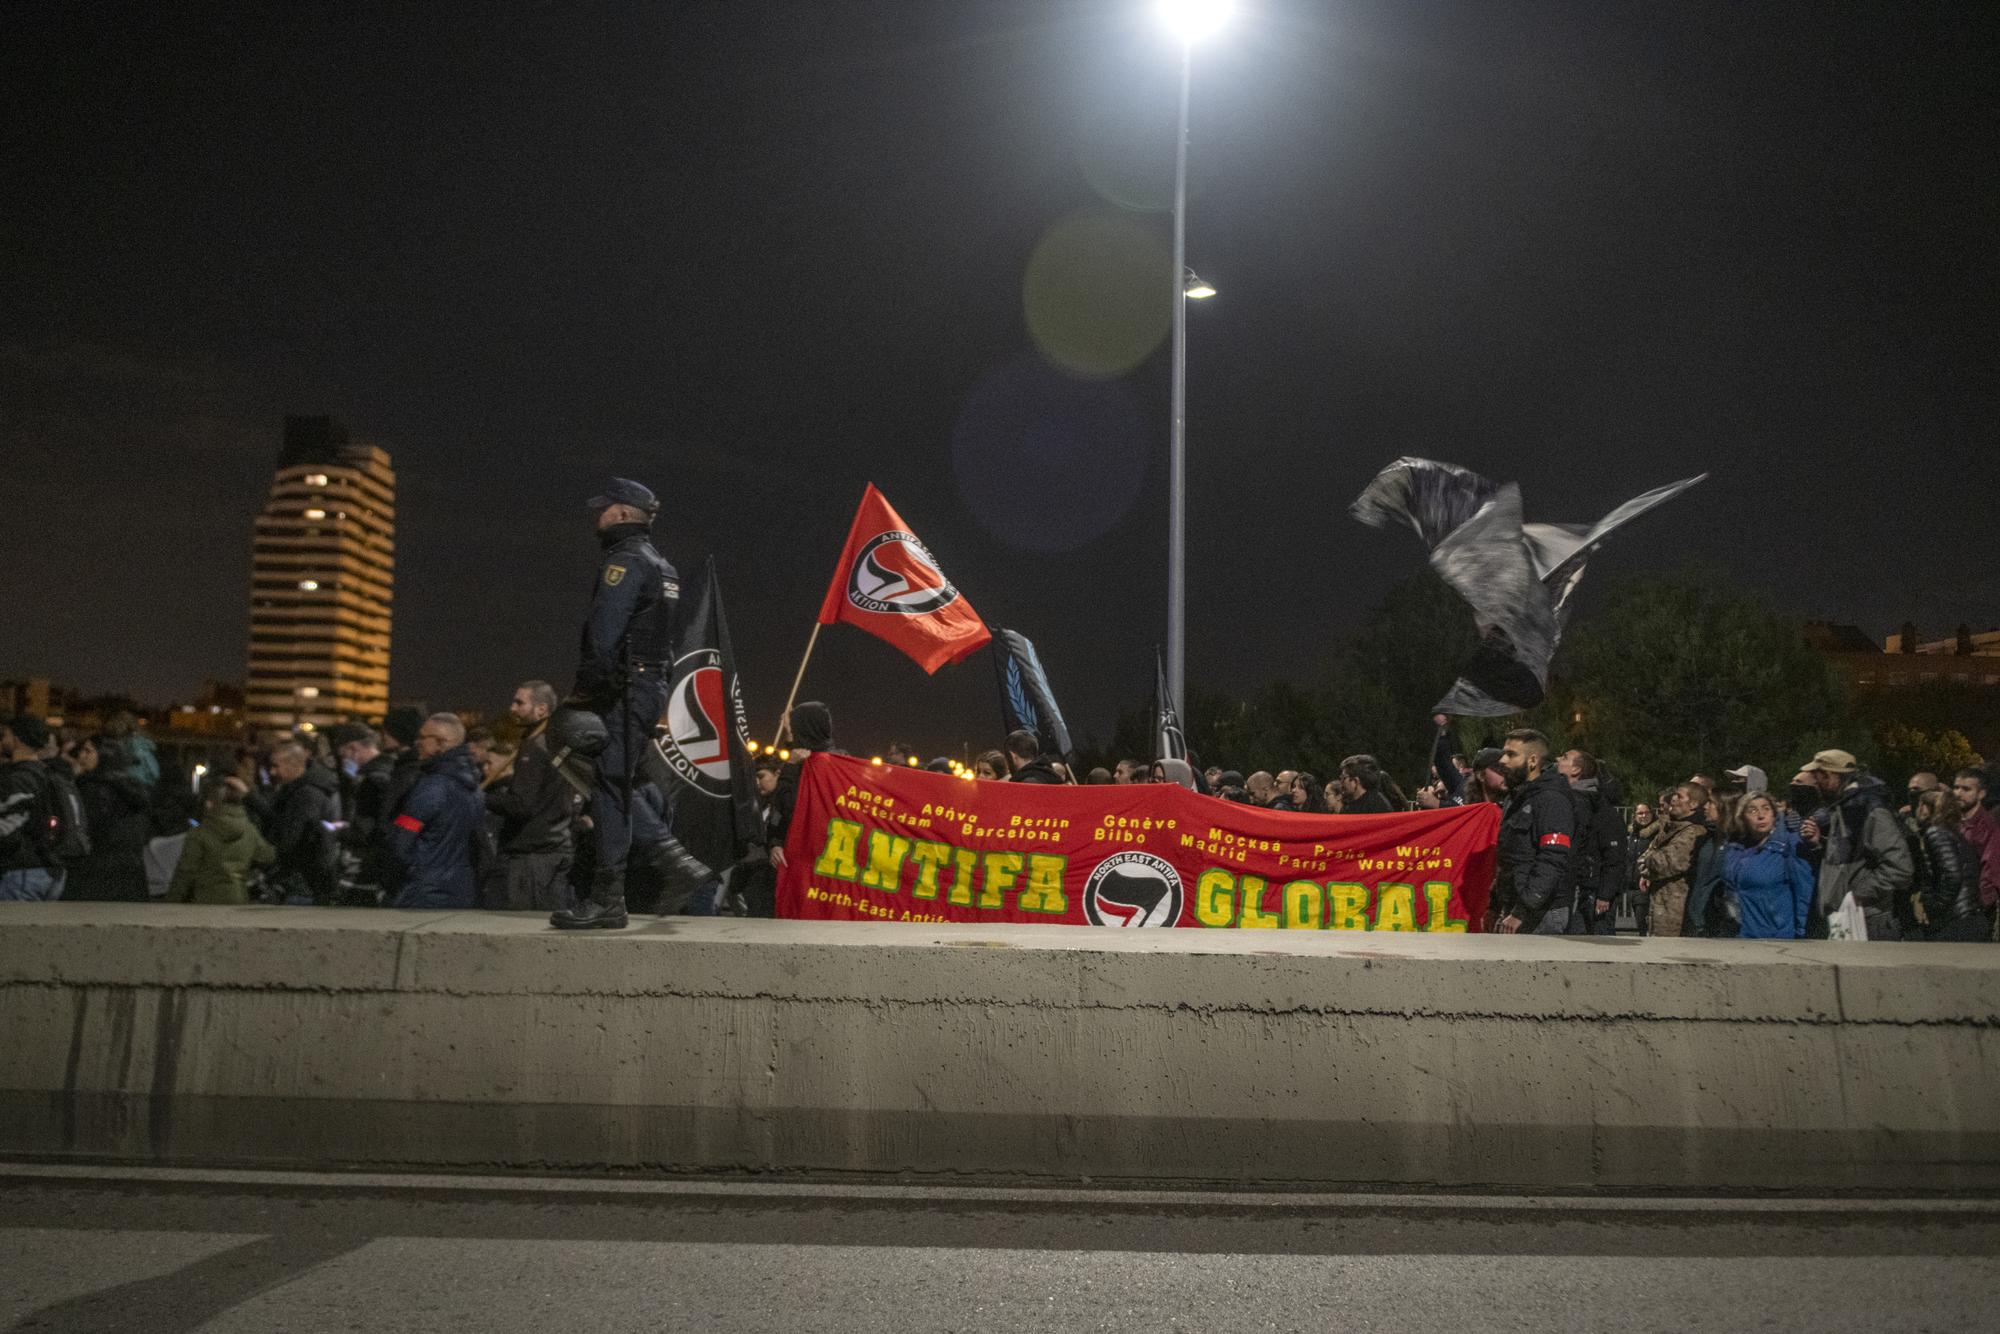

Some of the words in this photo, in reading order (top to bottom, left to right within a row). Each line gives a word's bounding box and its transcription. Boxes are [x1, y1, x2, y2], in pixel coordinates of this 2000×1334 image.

[850, 590, 889, 611] AKTION
[659, 734, 699, 781] KTION
[836, 795, 931, 828] Amsterdam
[961, 823, 1061, 842] Barcelona
[1094, 827, 1146, 844] Bilbo
[1180, 834, 1247, 861] Madrid
[1279, 855, 1327, 871] Paris
[1358, 857, 1452, 871] Warszawa
[847, 785, 895, 808] Amed
[1010, 815, 1070, 828] Berlin
[1103, 814, 1177, 831] Genève
[1396, 845, 1441, 858] Wien
[815, 817, 1067, 913] ANTIFA
[1195, 867, 1468, 932] GLOBAL
[1093, 855, 1123, 881] NORTH
[1124, 854, 1152, 864] EAST
[1151, 859, 1179, 886] ANTIFA
[807, 887, 895, 920] North-East
[900, 910, 951, 923] Antif
